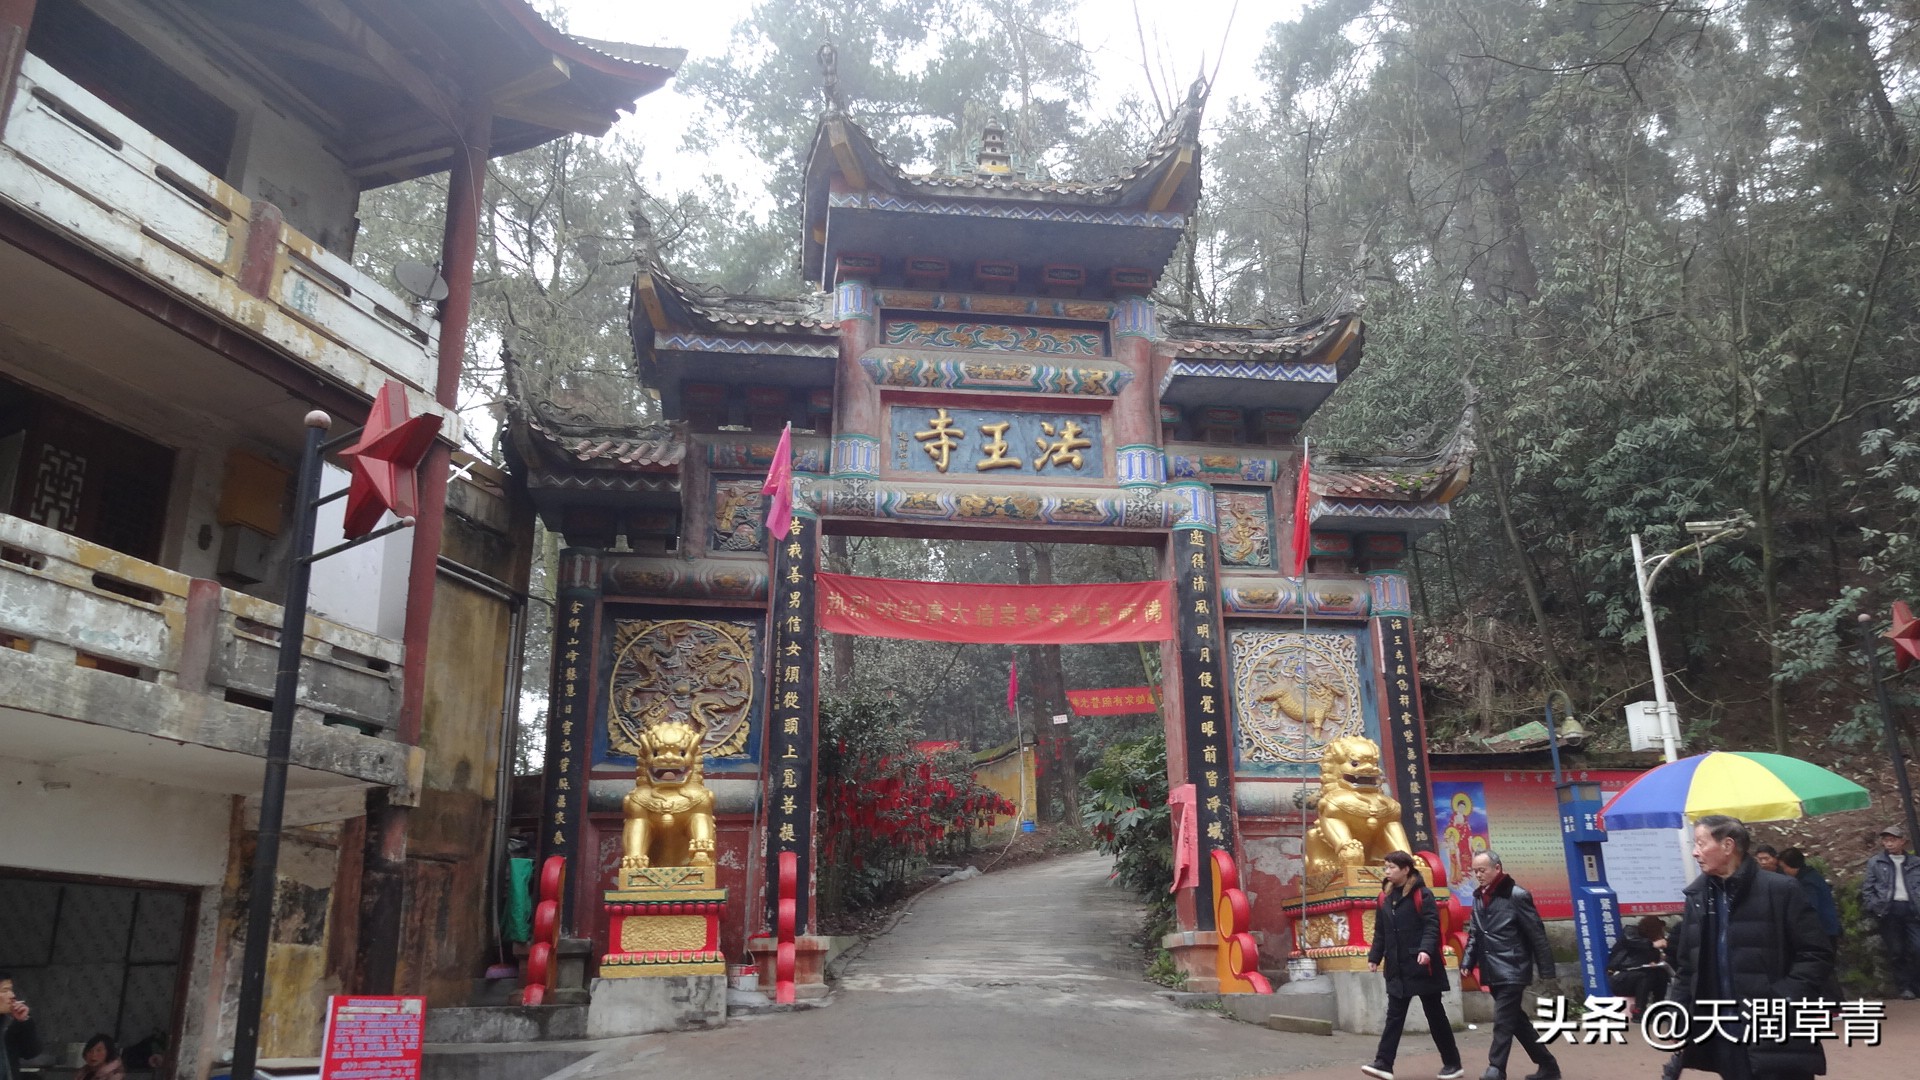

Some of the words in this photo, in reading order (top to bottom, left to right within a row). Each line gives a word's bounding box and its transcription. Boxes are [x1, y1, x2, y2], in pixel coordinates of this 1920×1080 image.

[914, 408, 1091, 473] 法王寺
[1600, 898, 1618, 954] 紧急报警
